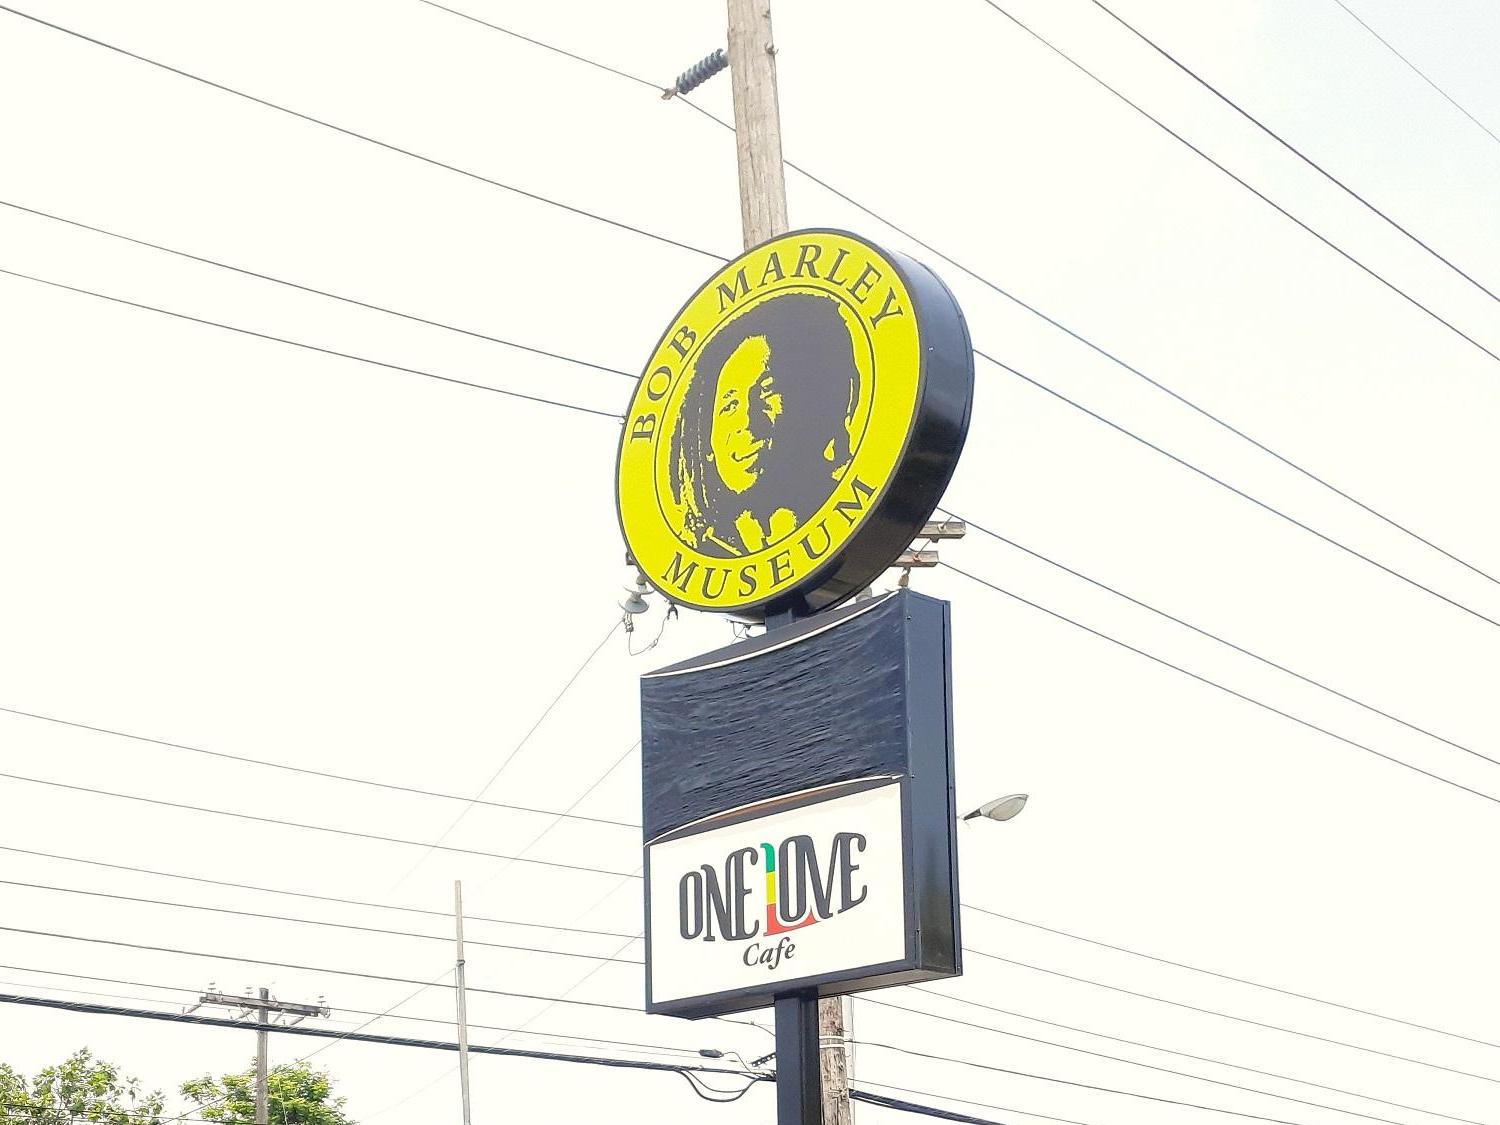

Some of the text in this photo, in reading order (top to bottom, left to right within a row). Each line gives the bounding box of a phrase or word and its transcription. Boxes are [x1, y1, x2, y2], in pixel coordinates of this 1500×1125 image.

[630, 243, 905, 443] BOB MARLEY
[661, 474, 878, 601] MUSEUM
[678, 832, 868, 942] ONE LOVE
[742, 936, 796, 970] Cafe
